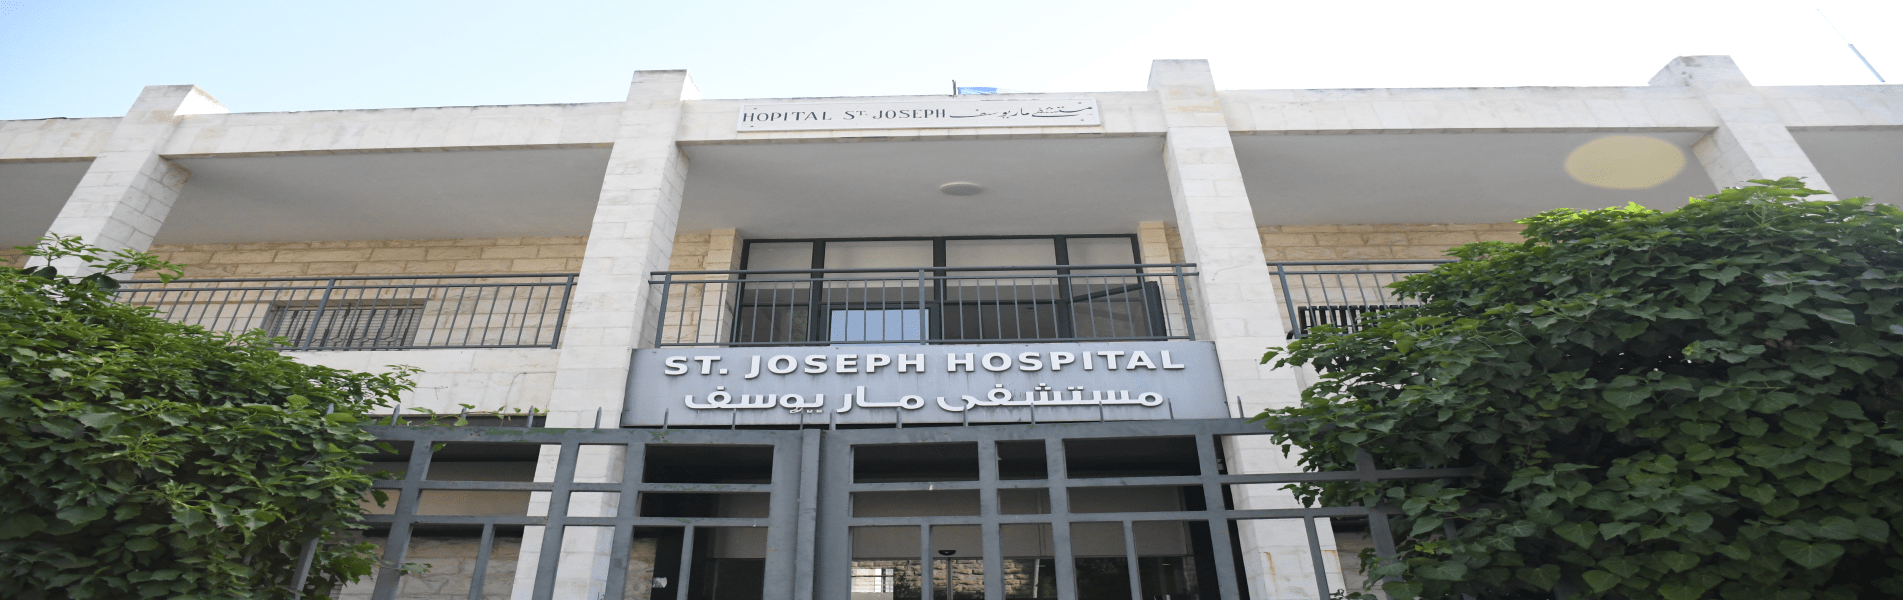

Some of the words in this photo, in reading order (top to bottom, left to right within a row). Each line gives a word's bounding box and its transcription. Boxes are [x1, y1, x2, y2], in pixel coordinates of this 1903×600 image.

[742, 111, 832, 122] HOPITAL
[872, 108, 946, 119] JOSEPH
[664, 355, 729, 375] ST.
[744, 353, 925, 379] JOSEPH
[947, 350, 1185, 373] HOSPITAL
[684, 385, 825, 414] يوسف
[836, 385, 925, 413] مار
